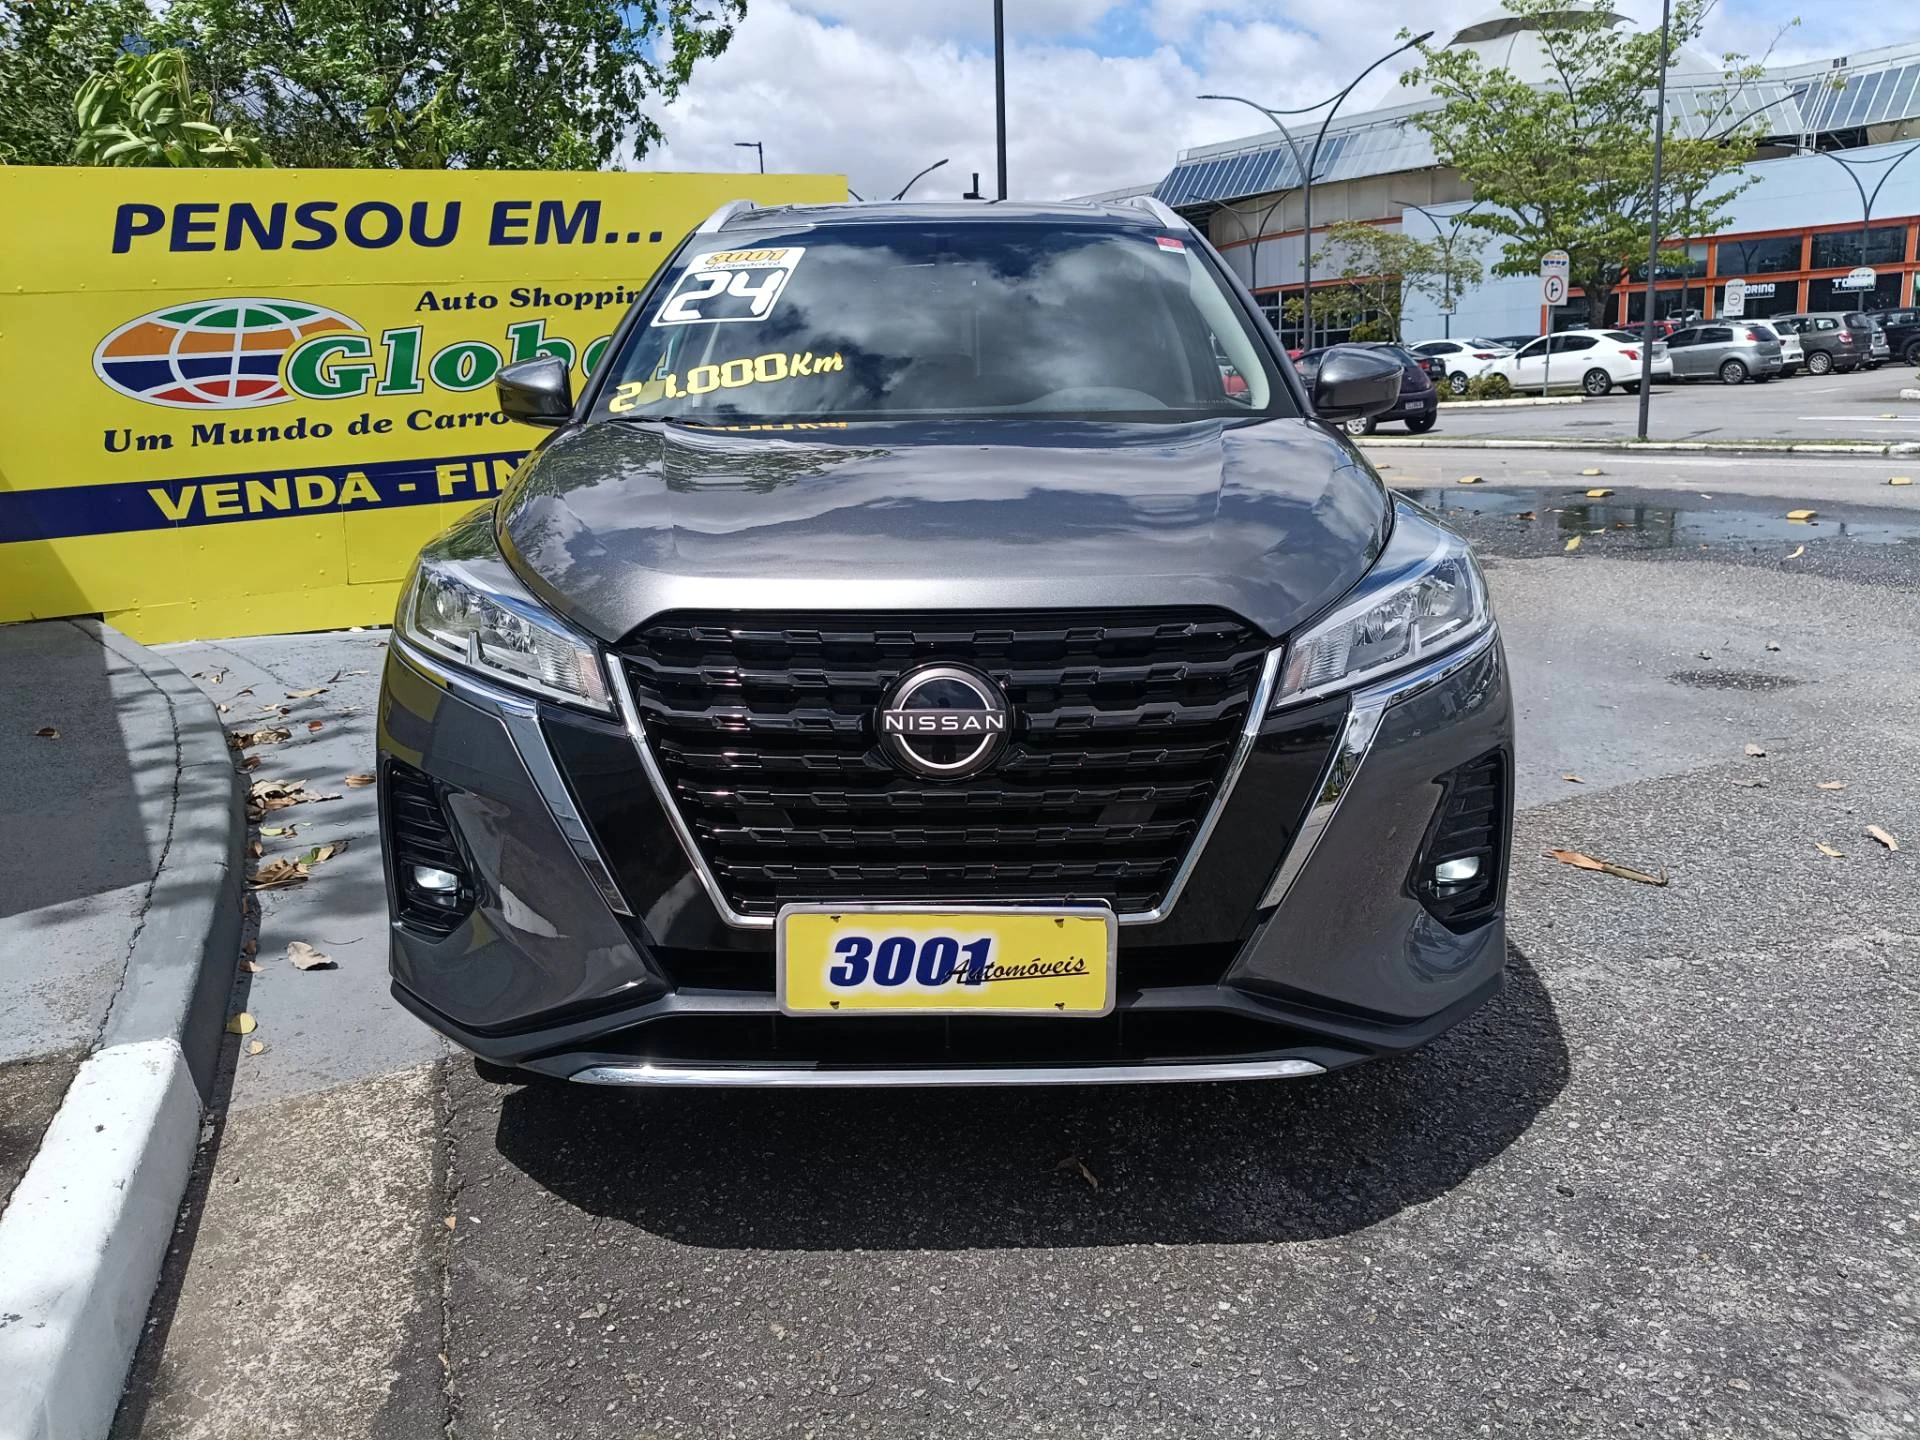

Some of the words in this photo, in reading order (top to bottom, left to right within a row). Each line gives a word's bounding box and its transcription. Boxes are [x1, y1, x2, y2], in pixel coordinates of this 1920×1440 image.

[111, 202, 462, 254] PENSOU
[488, 200, 663, 246] EM...
[415, 290, 498, 312] Auto
[662, 270, 785, 322] 24
[1744, 283, 1775, 294] ORINO
[103, 428, 173, 453] Um
[191, 417, 333, 447] Mundo
[347, 413, 393, 436] de
[147, 471, 382, 521] VENDA
[885, 714, 1004, 731] NISSAN
[829, 936, 992, 987] 3001
[942, 955, 1086, 985] Automóveis
